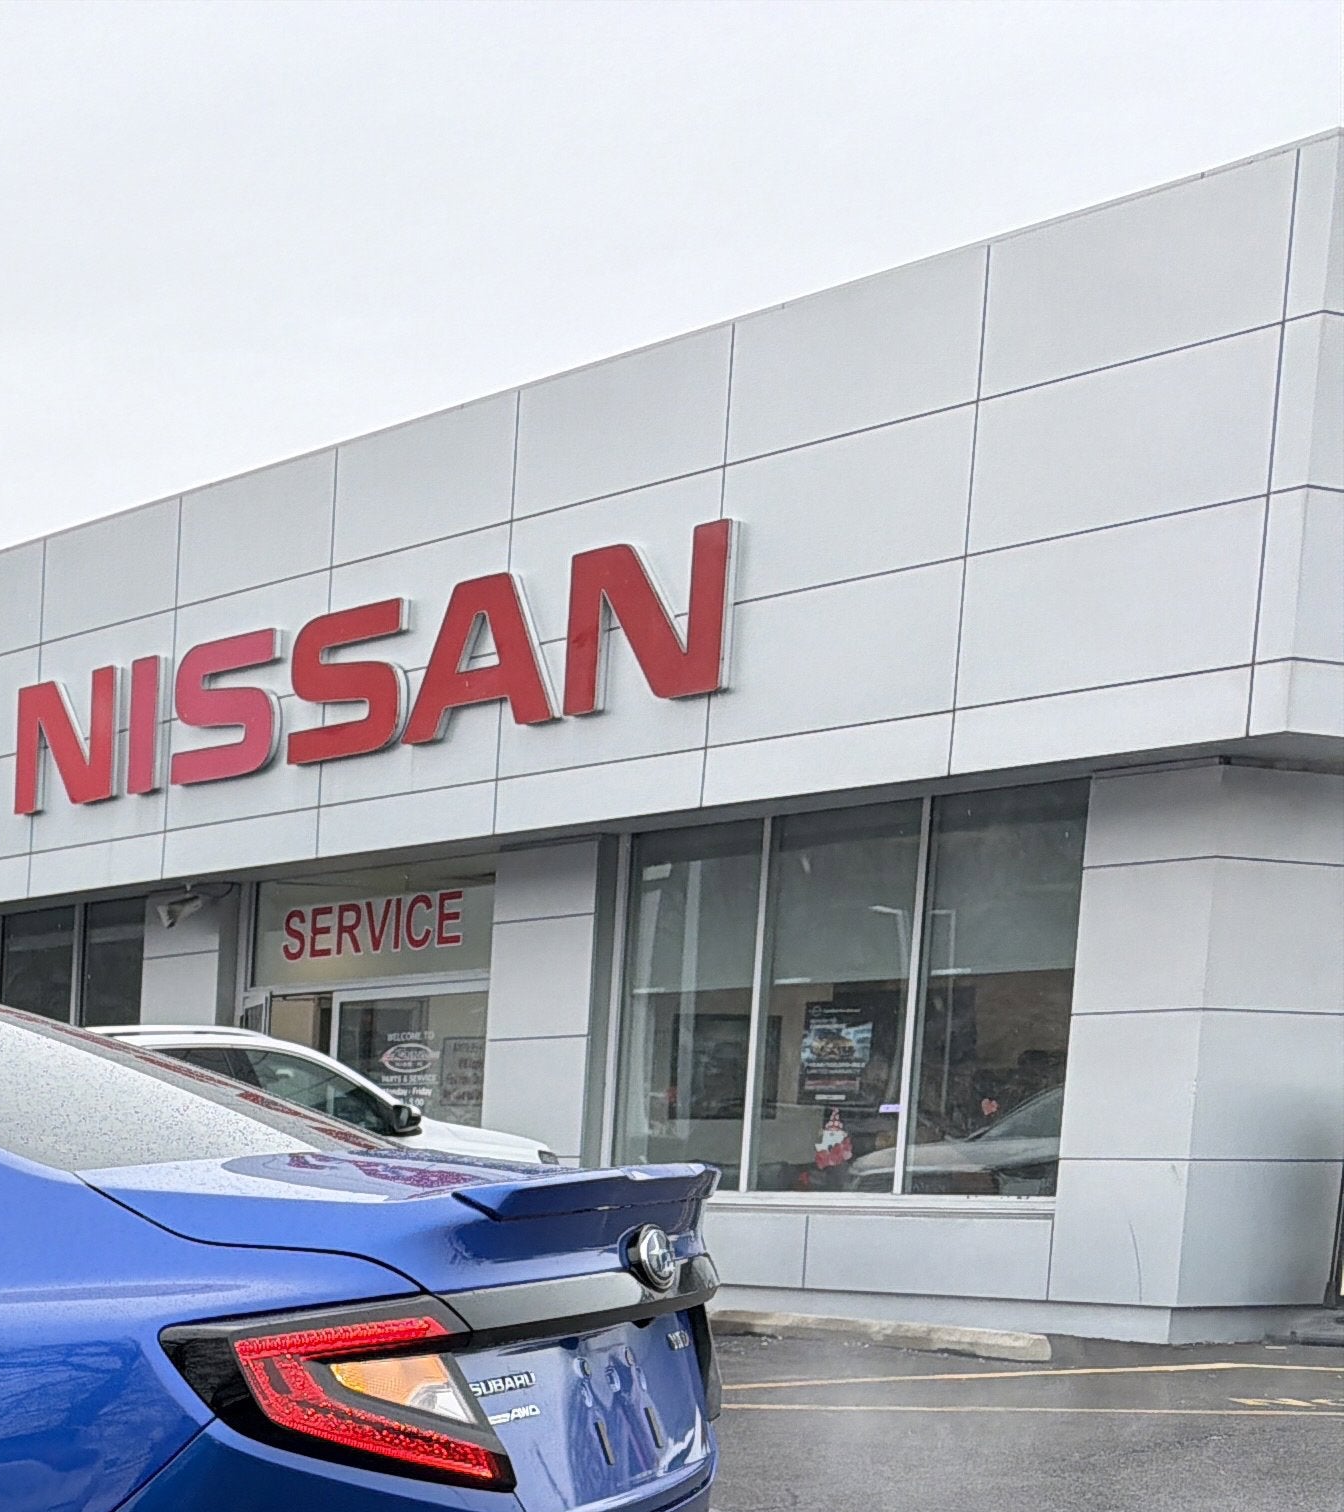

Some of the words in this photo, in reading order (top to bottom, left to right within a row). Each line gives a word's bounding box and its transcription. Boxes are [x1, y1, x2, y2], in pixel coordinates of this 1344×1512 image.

[14, 518, 736, 815] NISSAN
[281, 889, 465, 963] SERVICE
[469, 1371, 536, 1397] SUBARU
[510, 1404, 541, 1421] AWD
